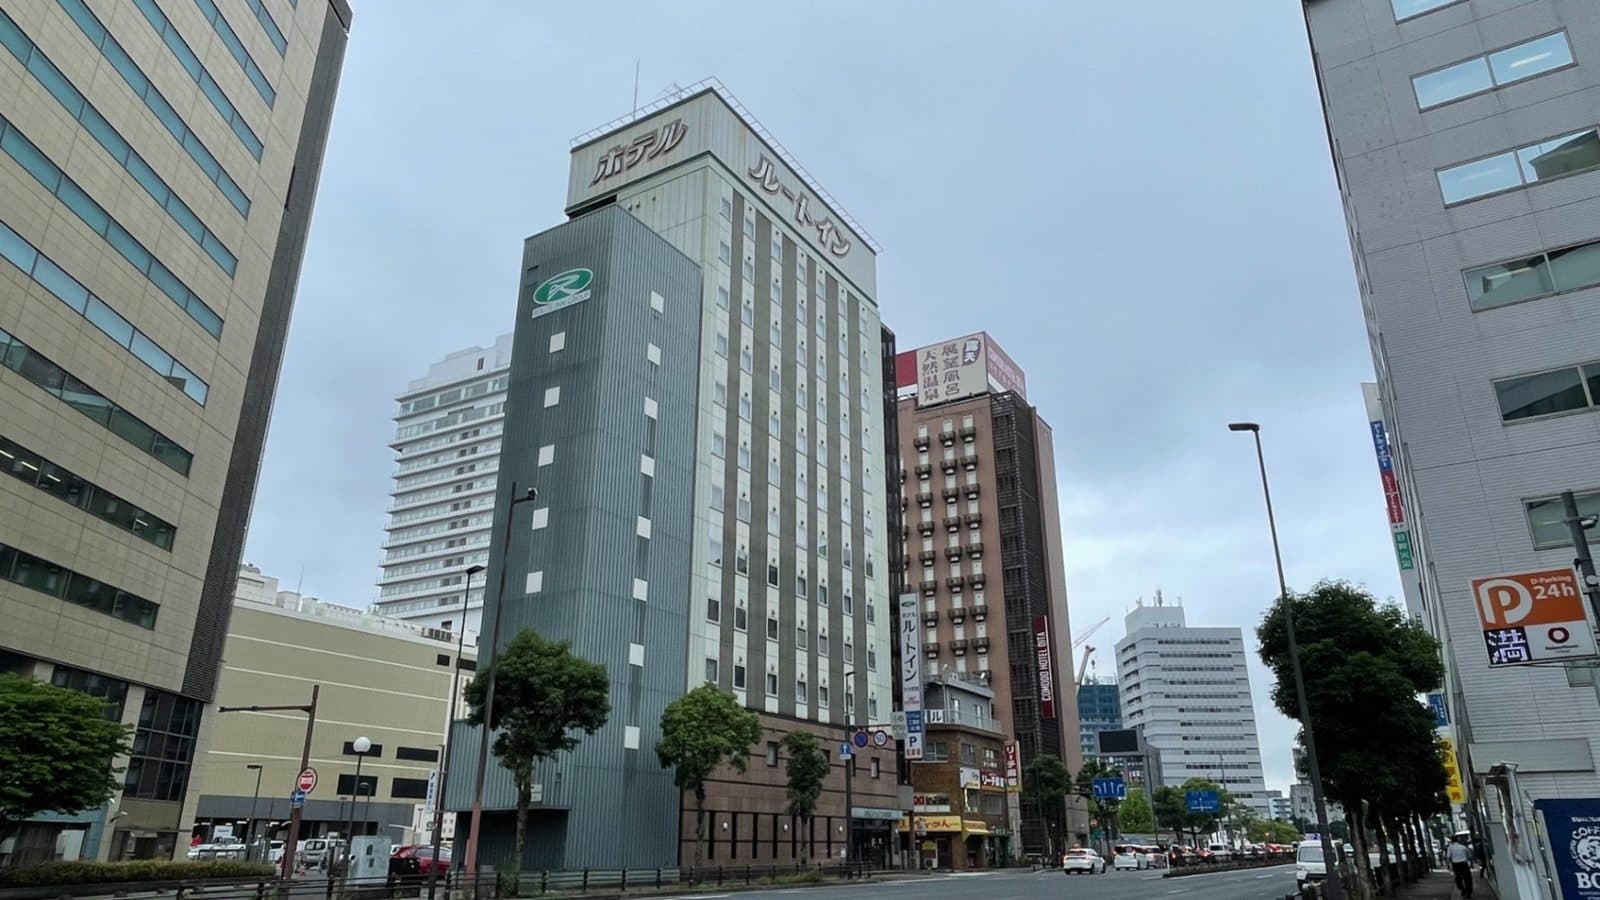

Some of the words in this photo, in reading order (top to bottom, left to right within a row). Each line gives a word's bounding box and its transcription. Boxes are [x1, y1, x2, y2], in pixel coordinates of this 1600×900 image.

[589, 118, 688, 186] ホテル
[747, 152, 851, 258] ルートイン
[921, 350, 940, 401] 天然温泉
[1478, 579, 1533, 624] P
[1533, 583, 1575, 599] 24h
[902, 619, 917, 682] ルートイン
[1038, 648, 1048, 670] HOTEL
[909, 736, 917, 748] P
